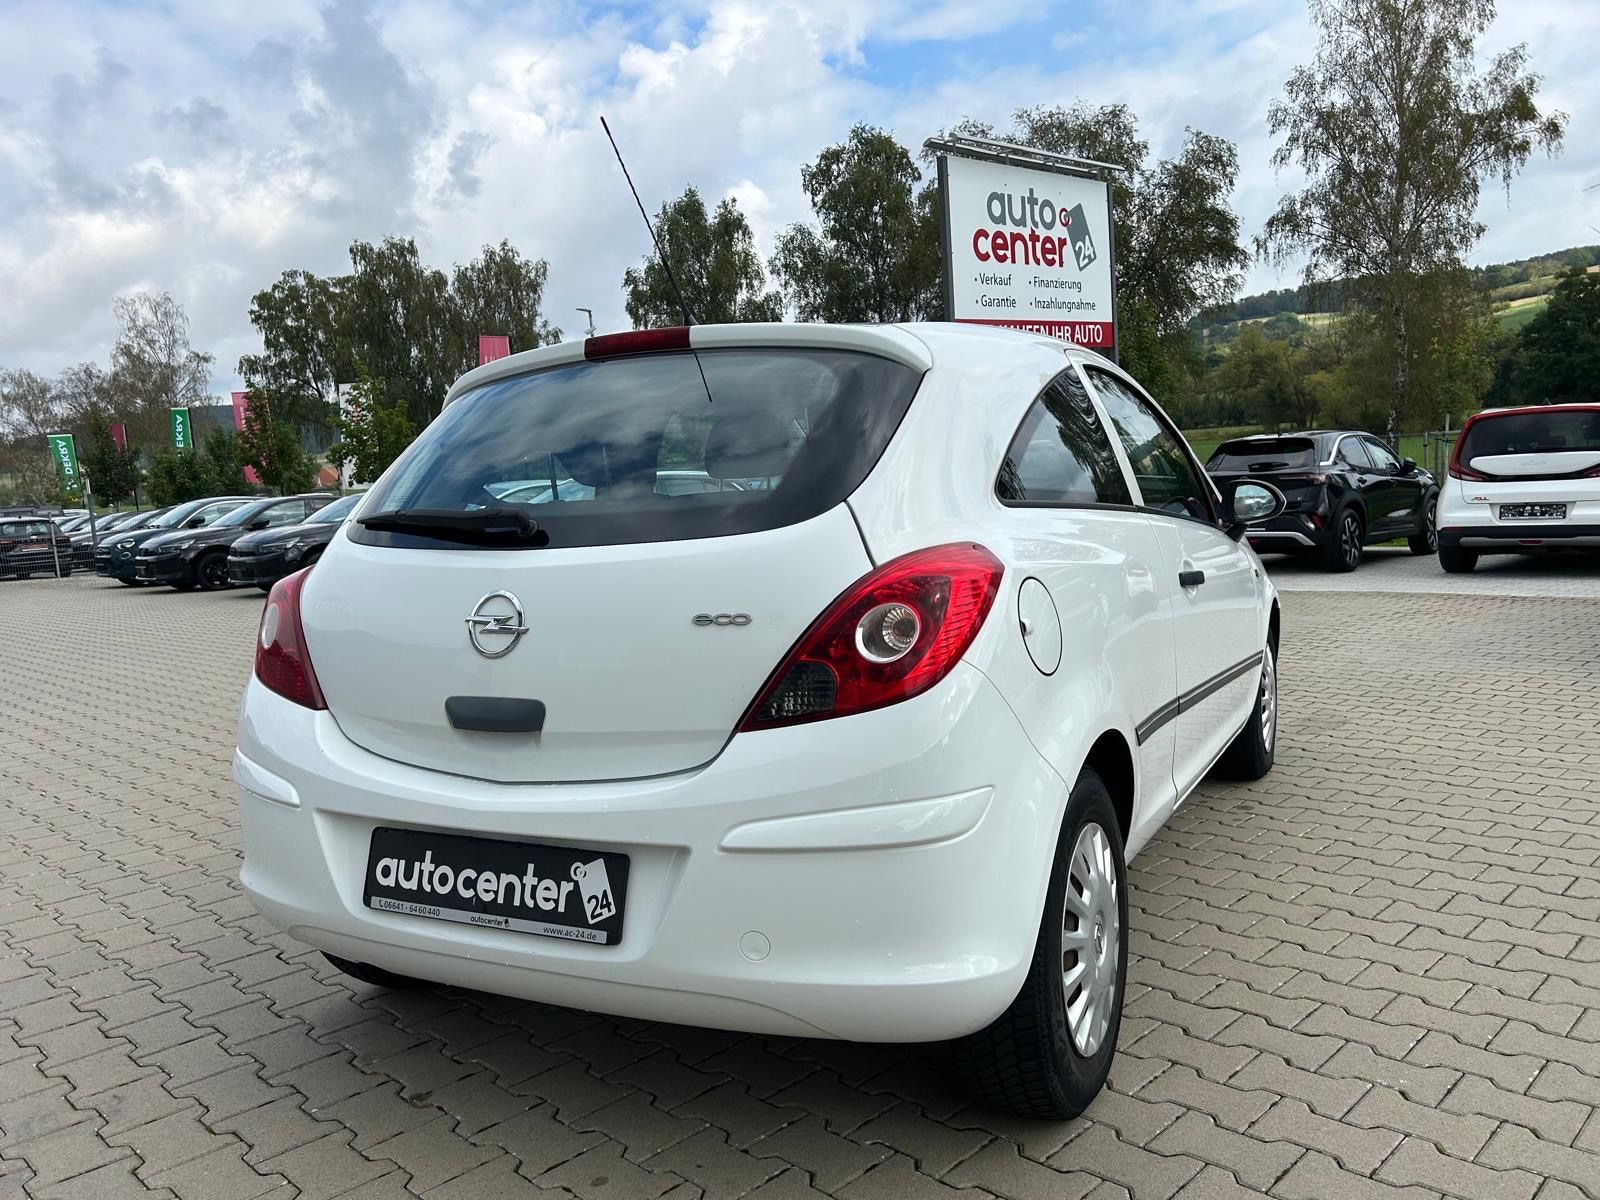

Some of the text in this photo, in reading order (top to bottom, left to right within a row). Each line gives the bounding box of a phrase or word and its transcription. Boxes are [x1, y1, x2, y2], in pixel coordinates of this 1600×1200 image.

[987, 188, 1056, 230] auto
[973, 228, 1067, 267] center
[1075, 235, 1095, 267] 24
[980, 273, 1012, 286] Verkauf
[1034, 276, 1082, 292] Finanzierung
[981, 295, 1016, 308] Garantie
[1034, 297, 1096, 312] Inzahlungnahme
[1052, 325, 1071, 342] IHR
[1074, 325, 1103, 343] AUTO
[692, 612, 753, 627] eco
[375, 850, 575, 913] autocenter
[587, 889, 612, 920] 24
[470, 915, 504, 927] autocenter
[543, 926, 597, 941] www.ac-24.de
